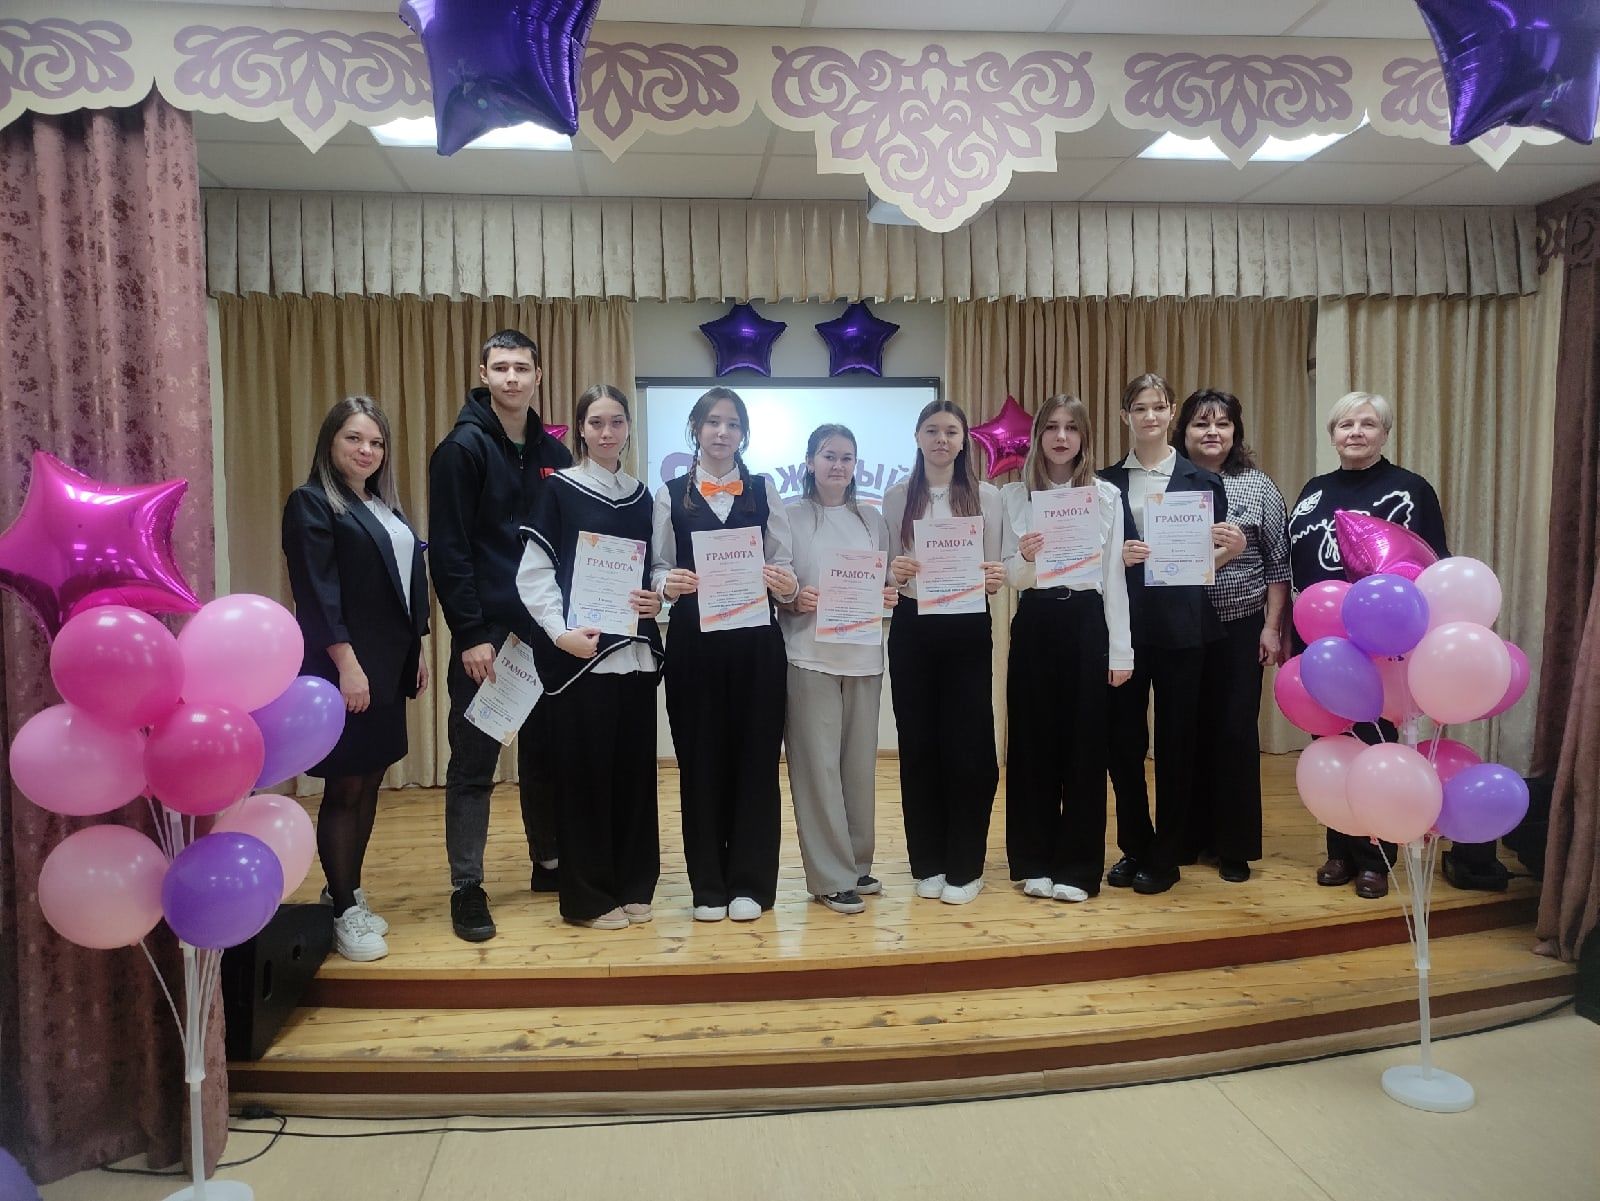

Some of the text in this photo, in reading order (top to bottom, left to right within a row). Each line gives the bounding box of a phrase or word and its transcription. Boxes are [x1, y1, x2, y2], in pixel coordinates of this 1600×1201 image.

[1044, 508, 1090, 518] ГРАМОТА
[1155, 514, 1204, 524] ГРАМОТА
[926, 539, 974, 549] ГРАМОТА
[706, 550, 754, 561] ГРАМОТА
[586, 557, 634, 572] ГРАМОТА
[830, 569, 876, 580] ГРАМОТА
[501, 656, 537, 687] ГРАМОТА
